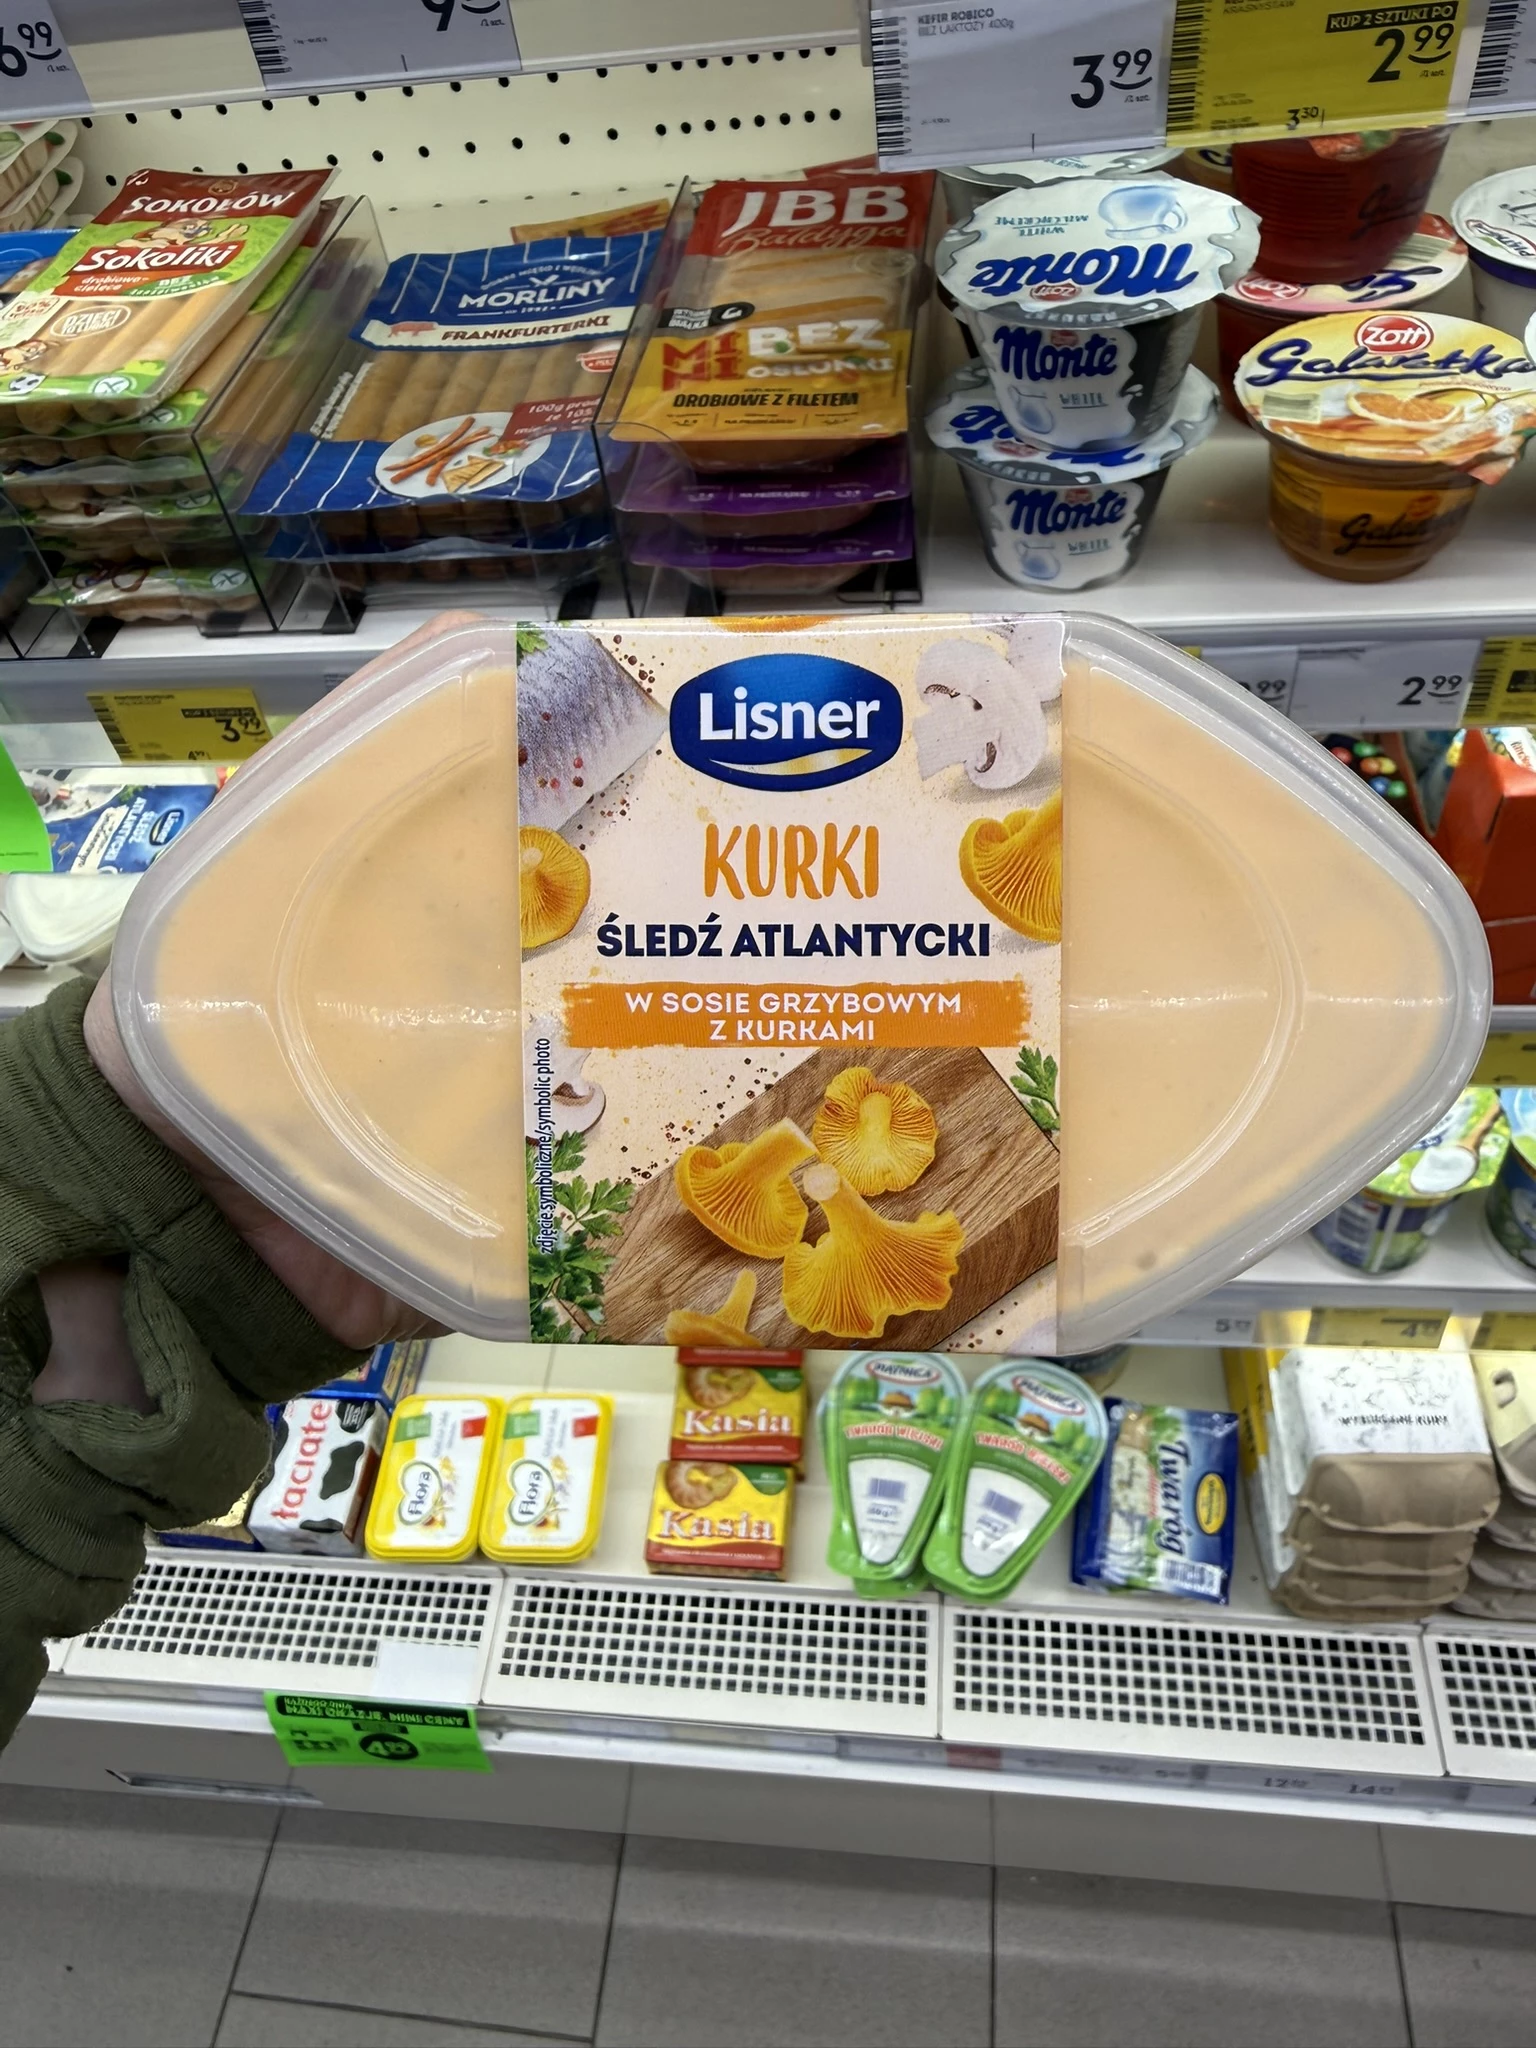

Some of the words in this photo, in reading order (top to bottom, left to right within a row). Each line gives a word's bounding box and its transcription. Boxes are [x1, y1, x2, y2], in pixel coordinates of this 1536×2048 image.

[918, 12, 950, 25] KEFIR
[951, 8, 995, 22] ROBICO
[1330, 16, 1359, 29] KUP
[1363, 14, 1373, 25] 2
[1374, 9, 1428, 24] SZTUKI
[1432, 5, 1455, 18] PO
[123, 190, 296, 216] SOKOŁÓW
[722, 186, 909, 238] JBB
[73, 244, 238, 272] Sokoliki
[971, 243, 1200, 298] Monte
[458, 276, 615, 308] MORLINY
[442, 315, 611, 341] FRANKFURTERKI
[748, 319, 890, 356] BEZ
[1364, 326, 1427, 346] Zott
[993, 326, 1119, 381] Monte
[673, 393, 770, 408] DROBIOWE
[772, 394, 783, 406] Z
[786, 392, 859, 407] FILETEM
[1005, 489, 1128, 535] Monte
[699, 686, 880, 742] Lisner
[104, 797, 147, 861] ATLANTYCKI
[704, 823, 879, 900] KURKI
[597, 912, 723, 959] ŚLEDŹ
[731, 923, 990, 958] ATLANTYCKI
[624, 993, 653, 1014] W
[662, 993, 751, 1014] SOSIE
[759, 992, 962, 1014] GRZYBOWYM
[709, 1020, 727, 1041] Z
[737, 1020, 876, 1041] KURKAMI
[533, 1038, 555, 1075] photo
[533, 1075, 557, 1211] symboliczne/symbolic
[536, 1211, 558, 1254] zdjęcie
[683, 1408, 792, 1436] Kasia
[408, 1470, 432, 1516] Flora
[519, 1469, 544, 1516] Flora
[1154, 1440, 1193, 1555] Twaróg
[659, 1508, 776, 1541] Kasia
